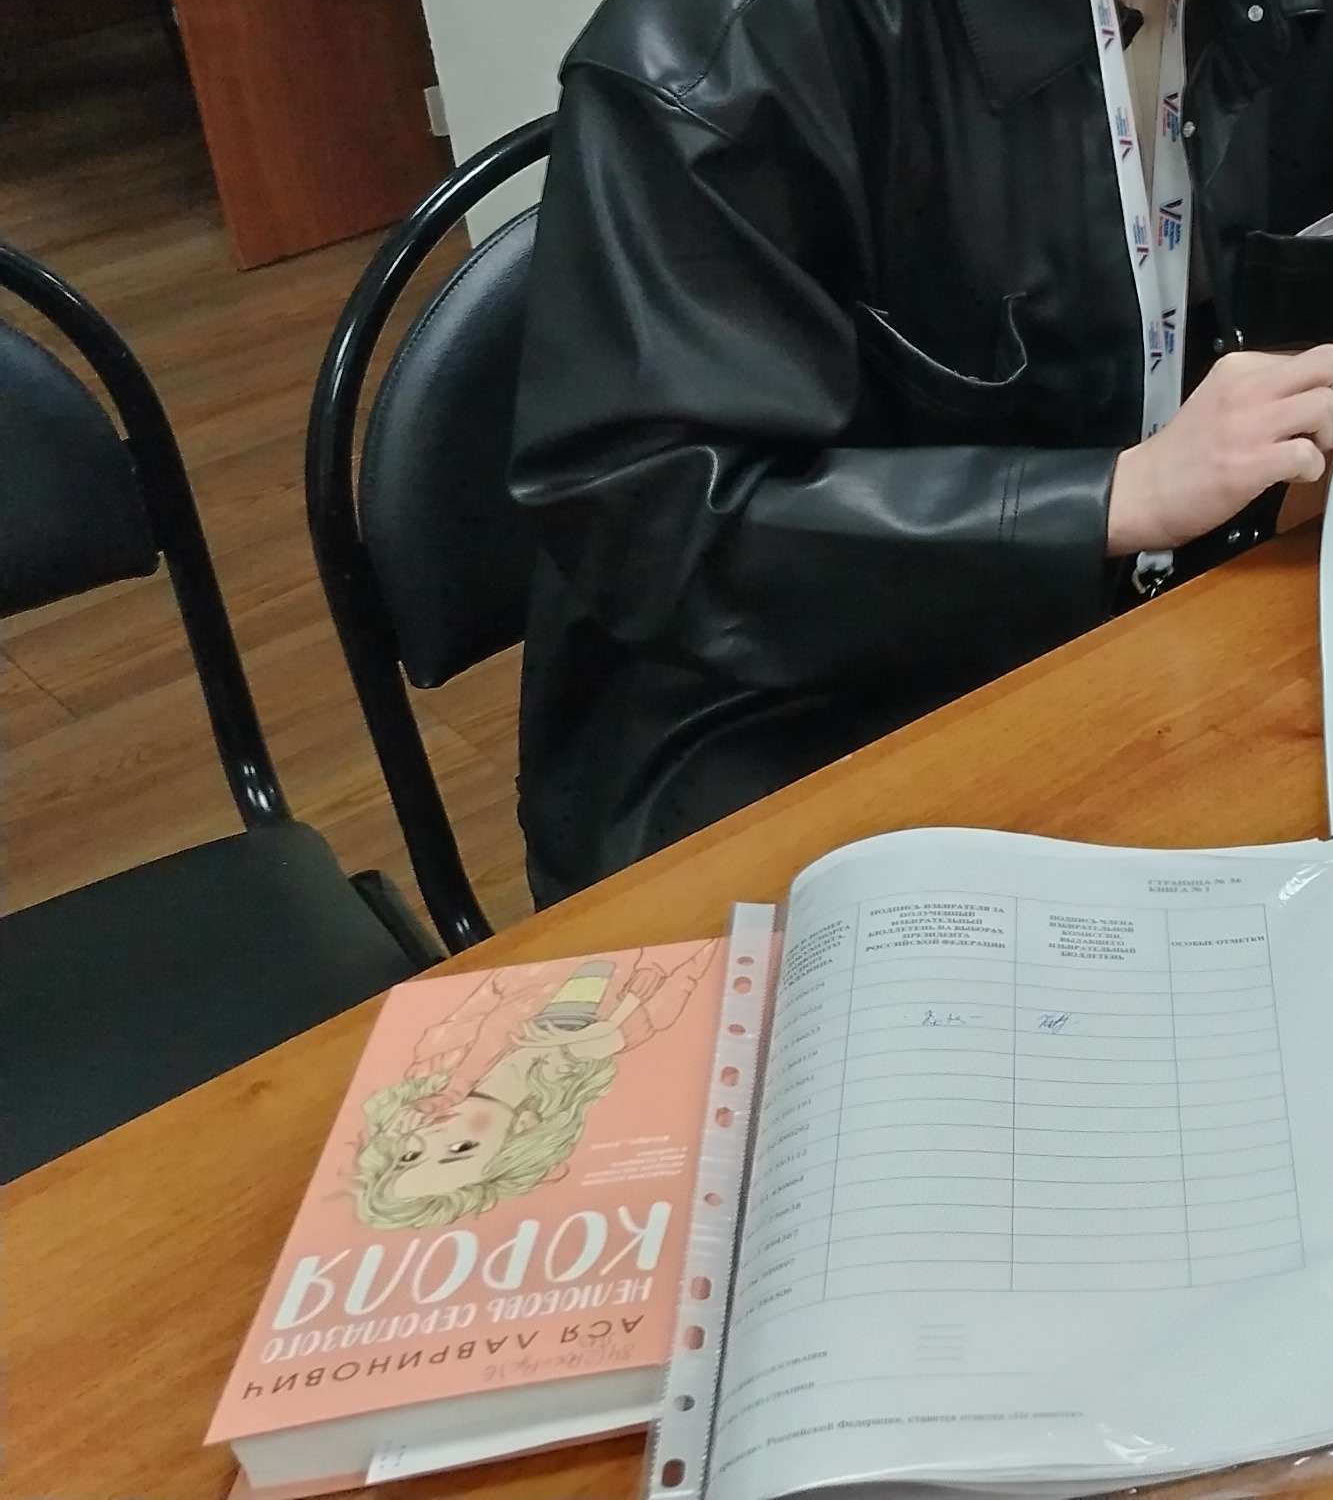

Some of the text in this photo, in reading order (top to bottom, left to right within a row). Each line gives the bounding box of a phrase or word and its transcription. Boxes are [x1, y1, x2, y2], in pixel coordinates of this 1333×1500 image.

[271, 1201, 671, 1330] КОРОЛЯ
[242, 1314, 643, 1399] АСЯ ЛАВРИНОВИЧ
[259, 1277, 651, 1364] НЕЛЮБОВЬ СЕРОГЛАЗОГО
